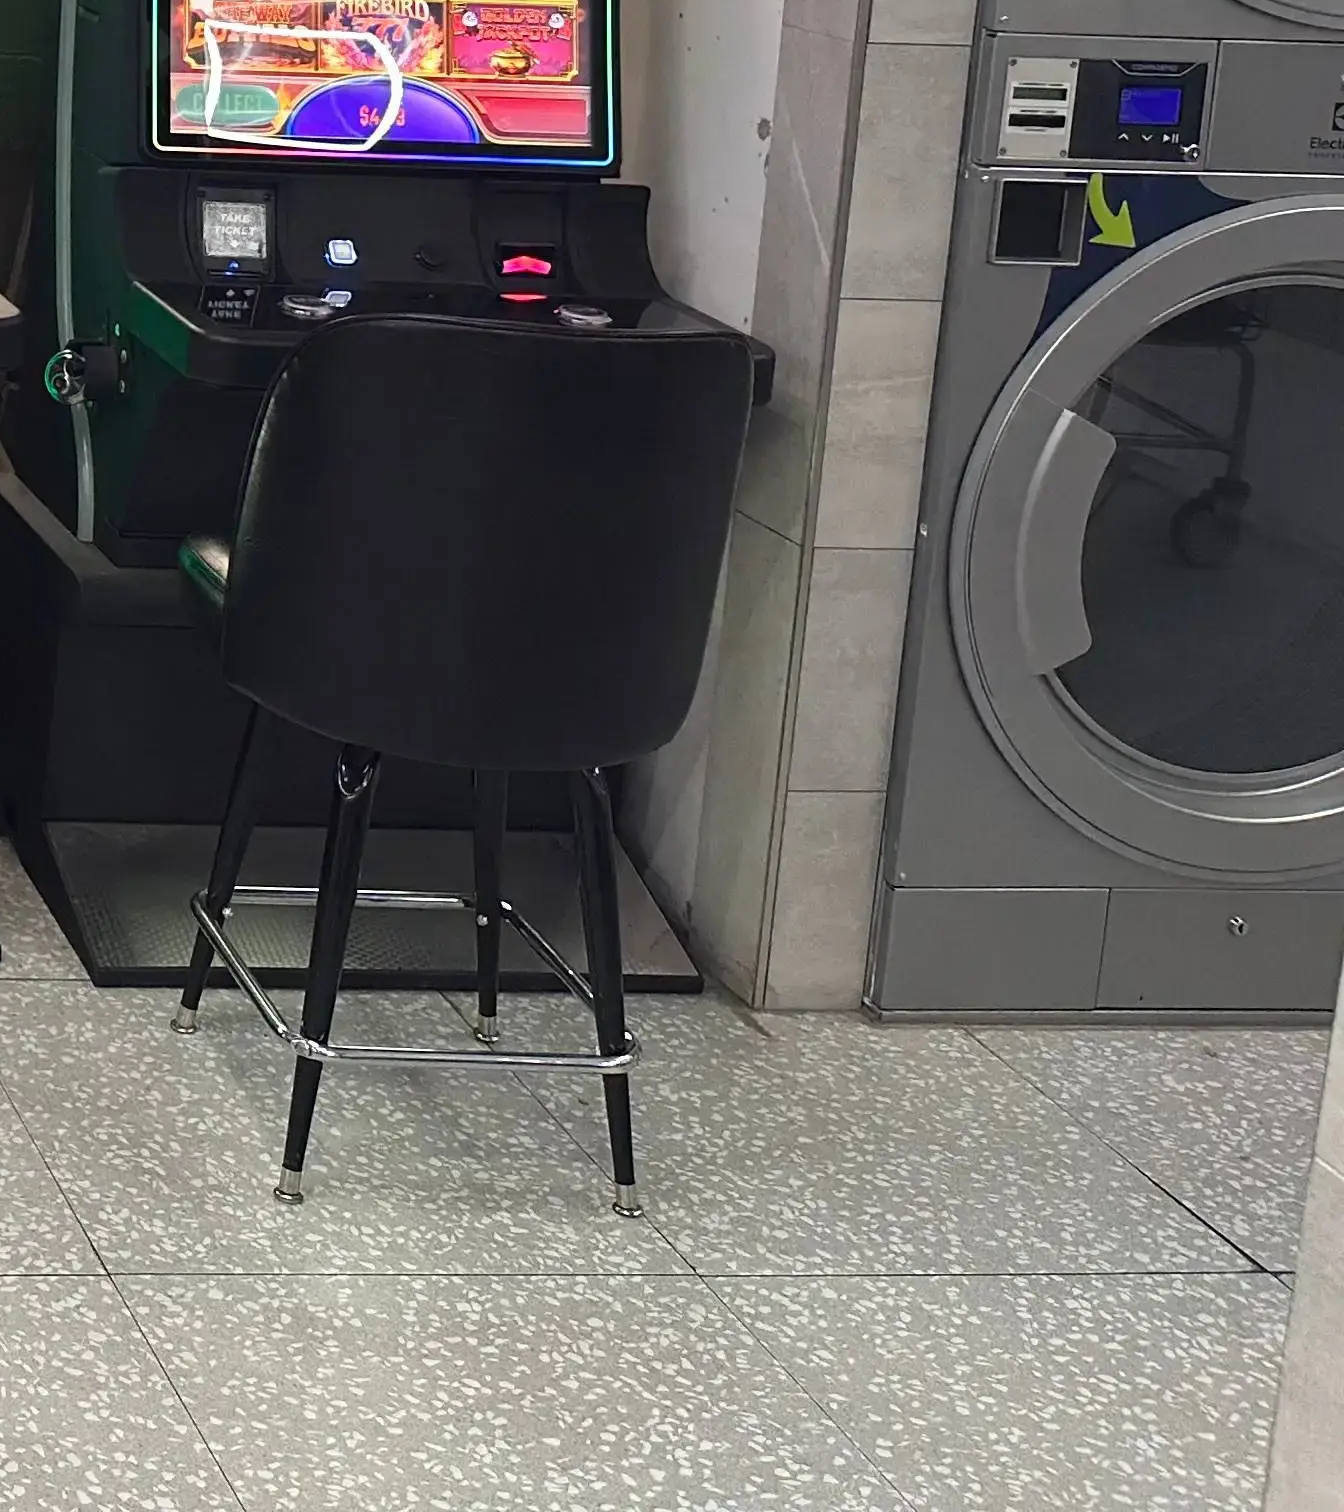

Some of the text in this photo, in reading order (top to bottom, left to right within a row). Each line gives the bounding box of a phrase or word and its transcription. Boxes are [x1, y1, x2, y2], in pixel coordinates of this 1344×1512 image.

[479, 7, 548, 24] GOLDEN
[477, 25, 552, 42] JACKPOT
[221, 213, 250, 224] TAKE
[215, 226, 257, 236] TICKET
